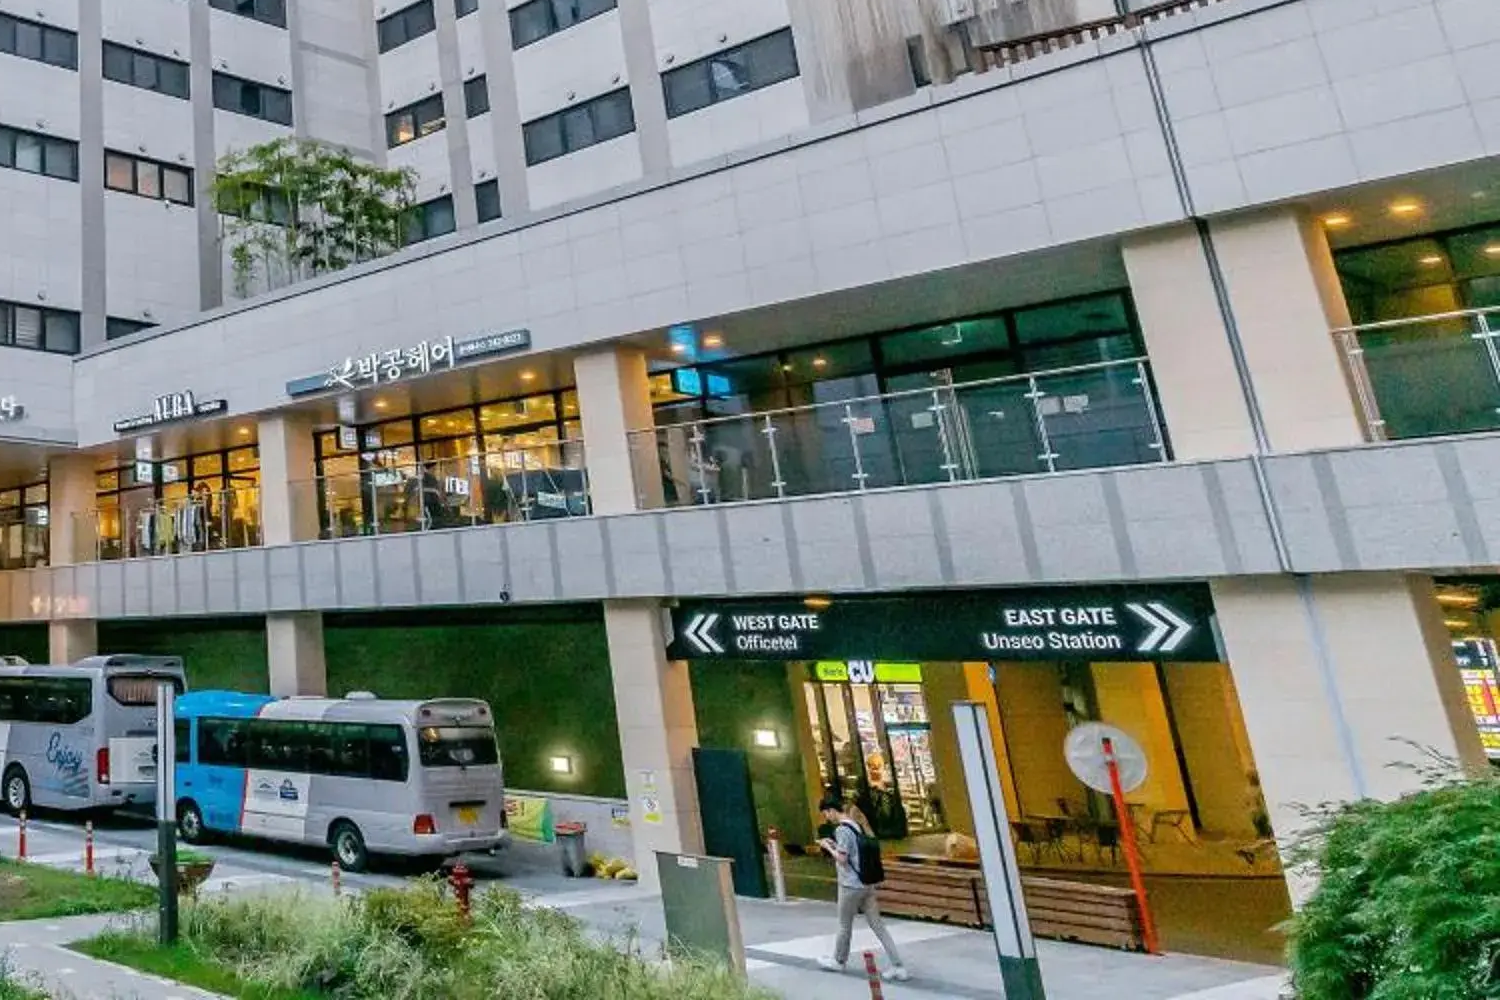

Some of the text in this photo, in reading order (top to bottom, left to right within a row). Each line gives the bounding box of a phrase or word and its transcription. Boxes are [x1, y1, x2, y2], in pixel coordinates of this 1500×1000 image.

[358, 336, 455, 383] 박공헤어
[732, 614, 819, 630] WEST GATE
[1005, 607, 1117, 625] EAST GATE
[736, 634, 797, 650] Officetel
[982, 631, 1122, 649] Unseo Station
[46, 732, 83, 773] Enjoy
